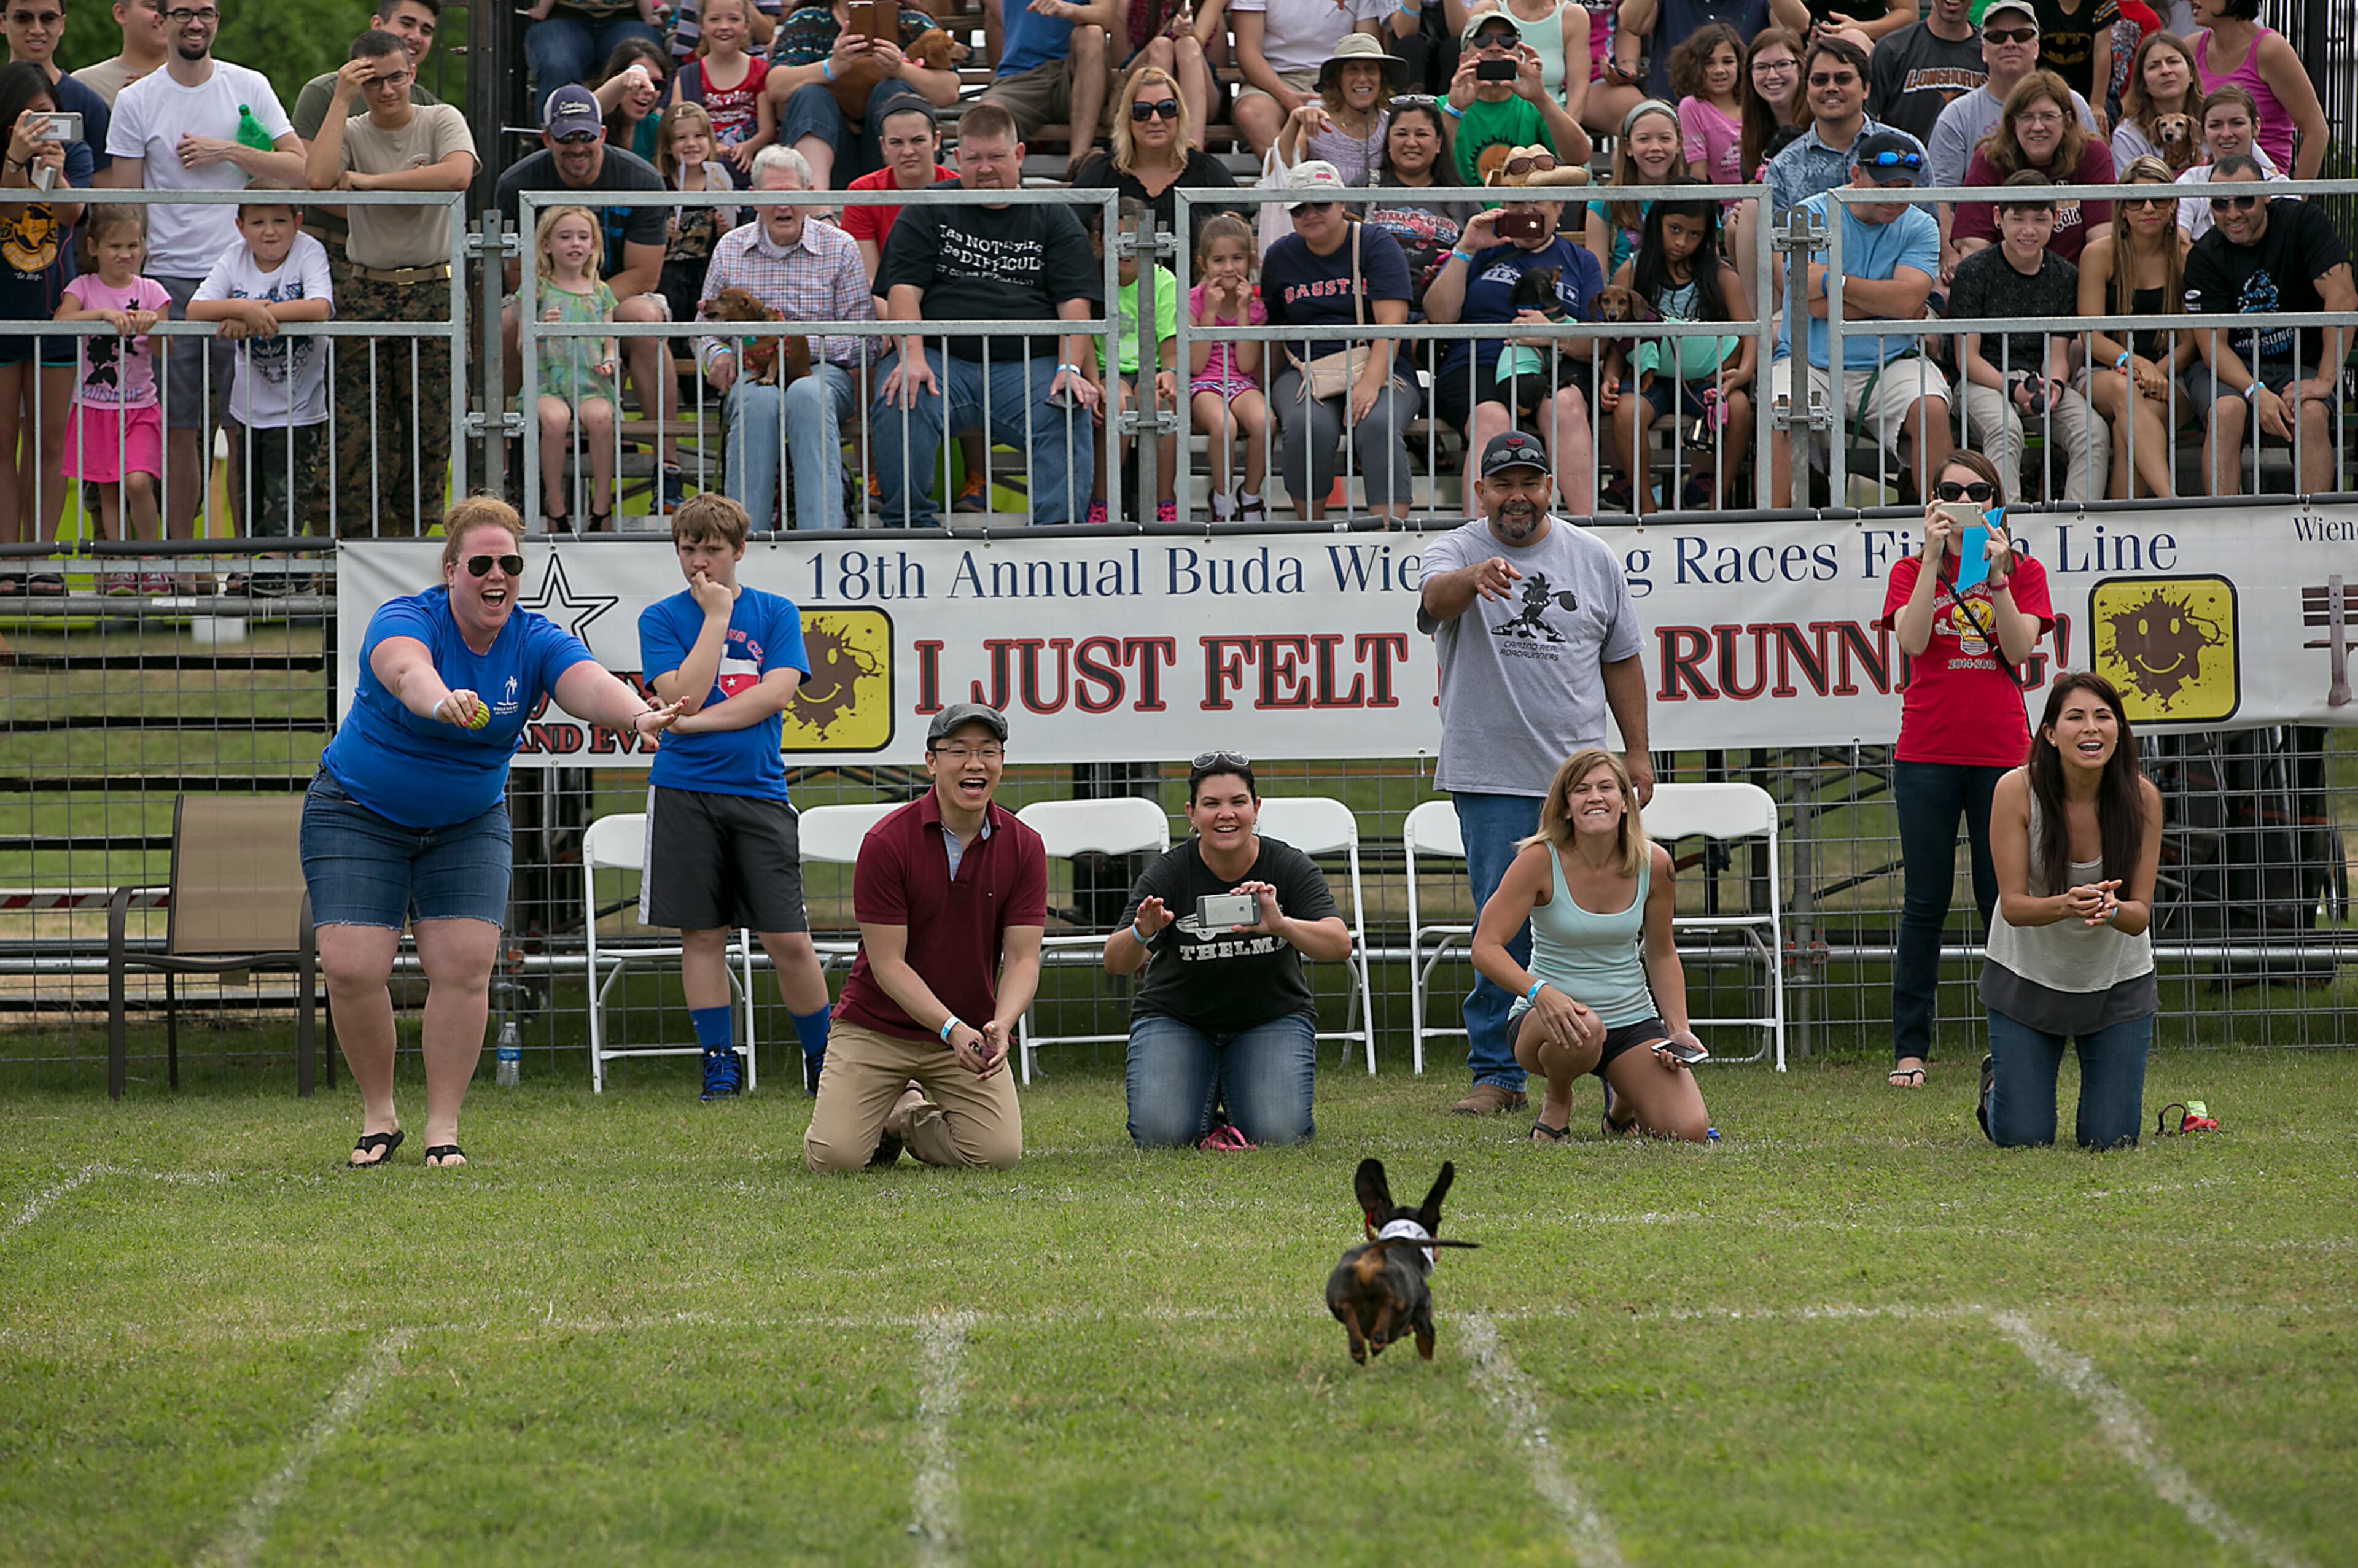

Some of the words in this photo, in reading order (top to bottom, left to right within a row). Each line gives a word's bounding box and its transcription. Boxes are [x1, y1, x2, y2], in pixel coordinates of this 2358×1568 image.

[965, 233, 1003, 254] NOT
[1285, 278, 1368, 304] BAUST
[2293, 516, 2358, 542] Wien
[807, 551, 928, 600] 18th
[947, 548, 1143, 599] Annual
[1165, 546, 1305, 595] Buda
[1324, 545, 1421, 592] Wie
[1673, 537, 1838, 584] Races
[1861, 527, 2030, 578] Fih
[2055, 524, 2177, 572] Line
[1500, 648, 1560, 661] ROADRUNNERS
[1503, 640, 1538, 651] CAMINO
[1539, 644, 1560, 653] REAL
[913, 640, 944, 715] I
[970, 636, 1176, 714] JUST
[1199, 632, 1408, 710] FELT
[1654, 613, 2071, 702] RUNN!
